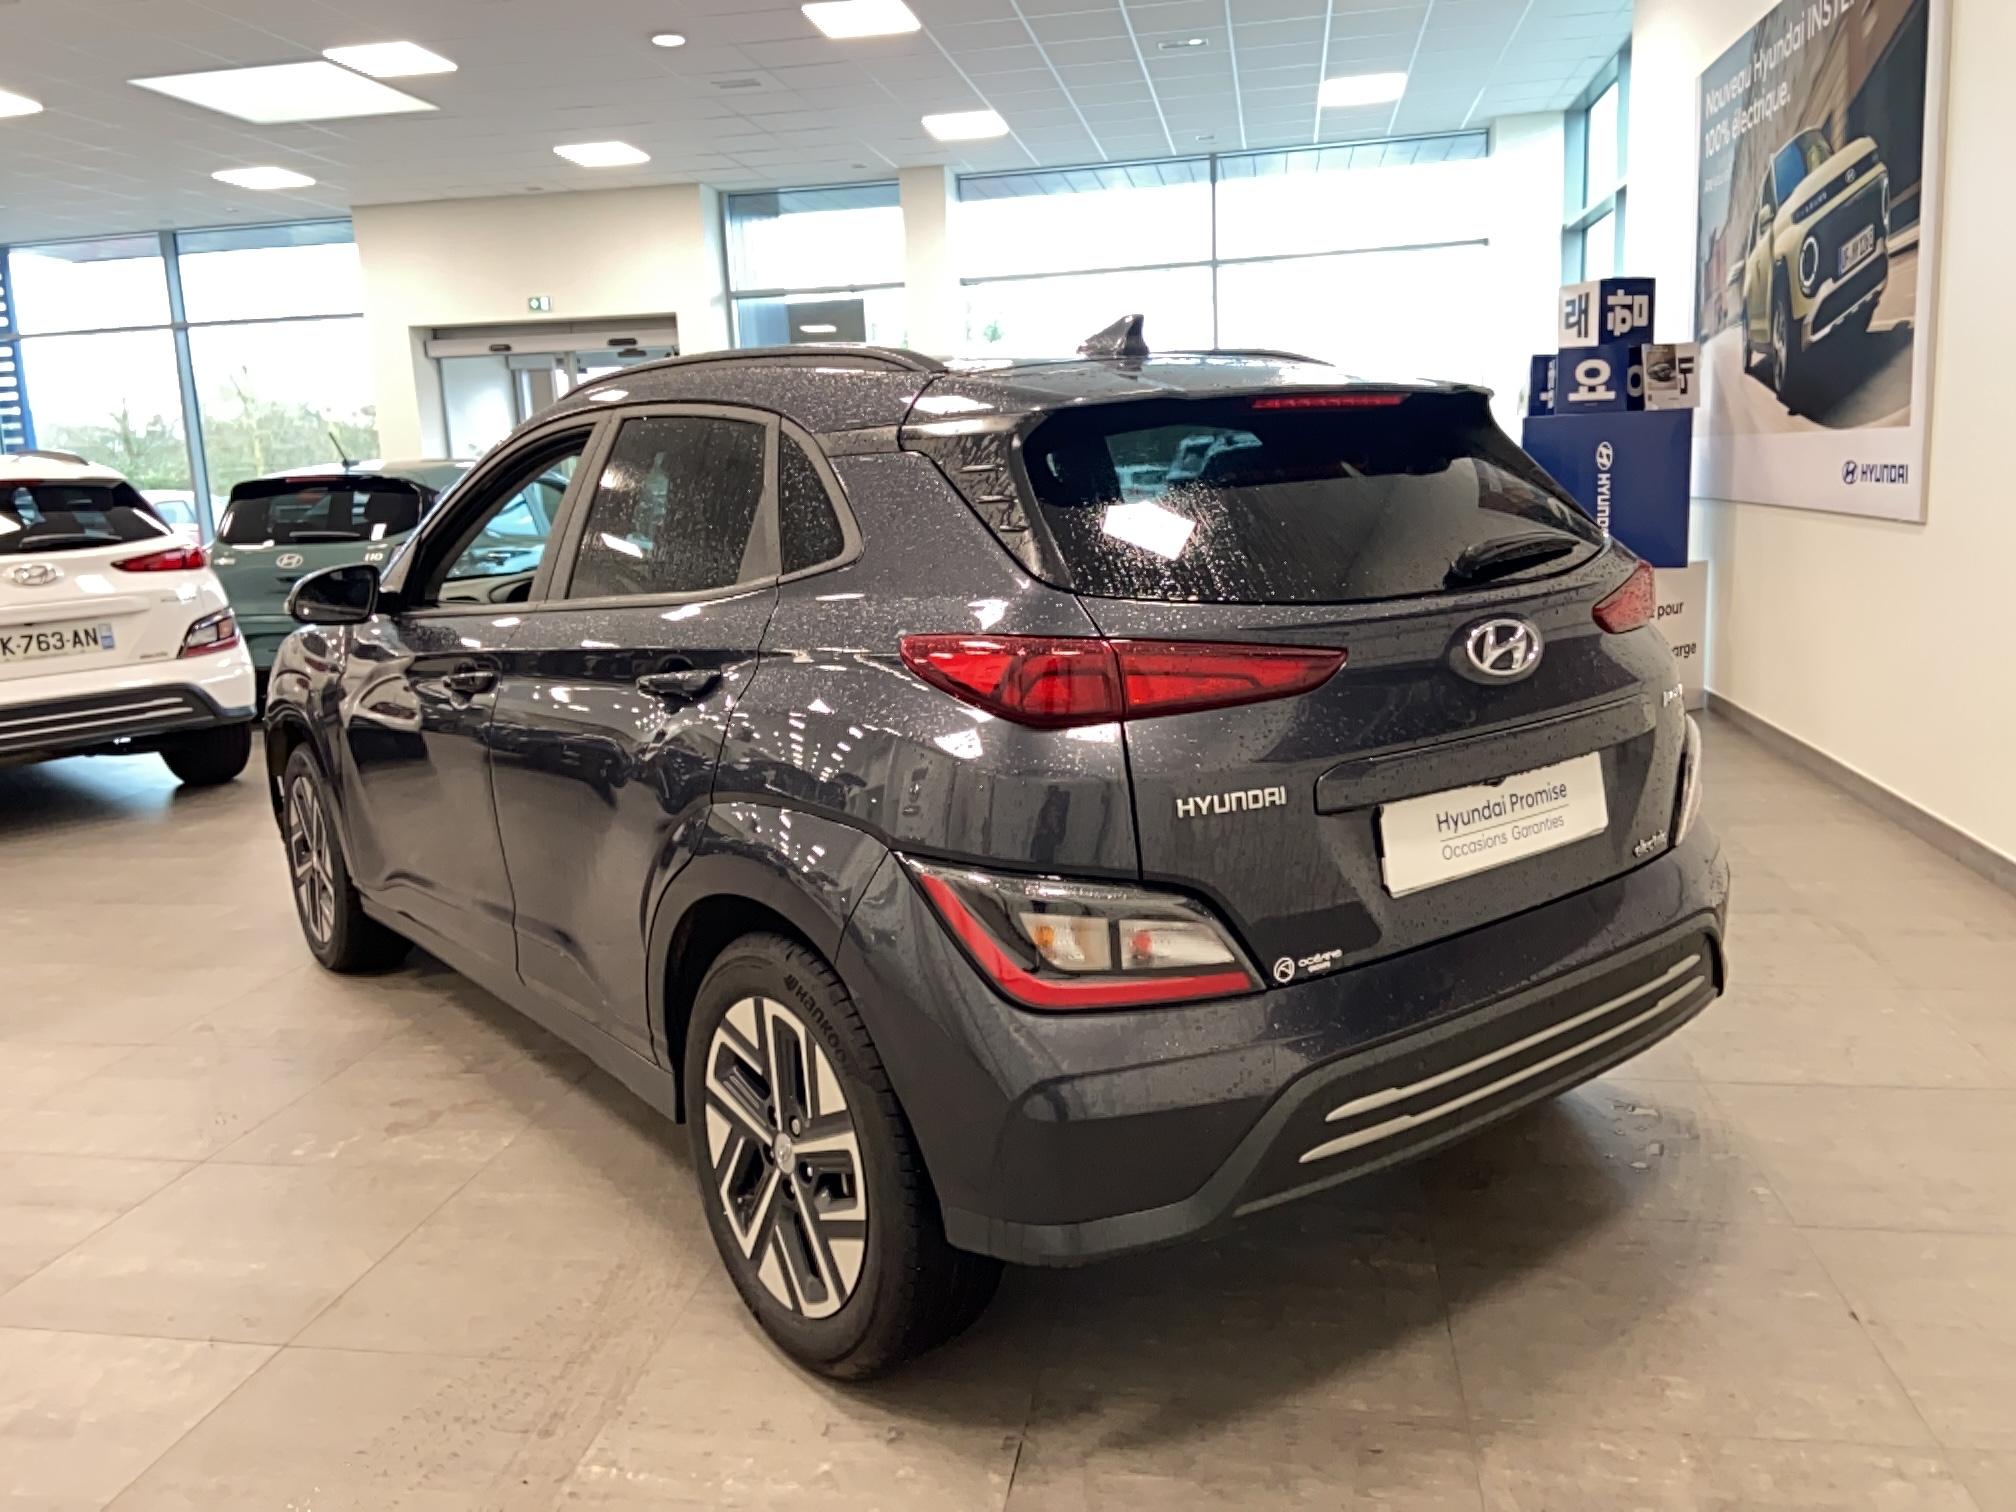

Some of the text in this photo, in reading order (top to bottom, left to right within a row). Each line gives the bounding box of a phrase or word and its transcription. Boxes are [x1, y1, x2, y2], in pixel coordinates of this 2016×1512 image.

[1705, 63, 1752, 120] Nouveau
[1753, 15, 1805, 83] Hyundai
[1704, 128, 1731, 159] 100%
[1861, 463, 1909, 484] HYUNDAI
[1657, 602, 1684, 620] pour
[1671, 643, 1697, 658] arge
[1176, 785, 1287, 819] HYUNDAI
[1436, 782, 1567, 833] Hyundai Promise
[1442, 815, 1565, 860] Occasions Garanties
